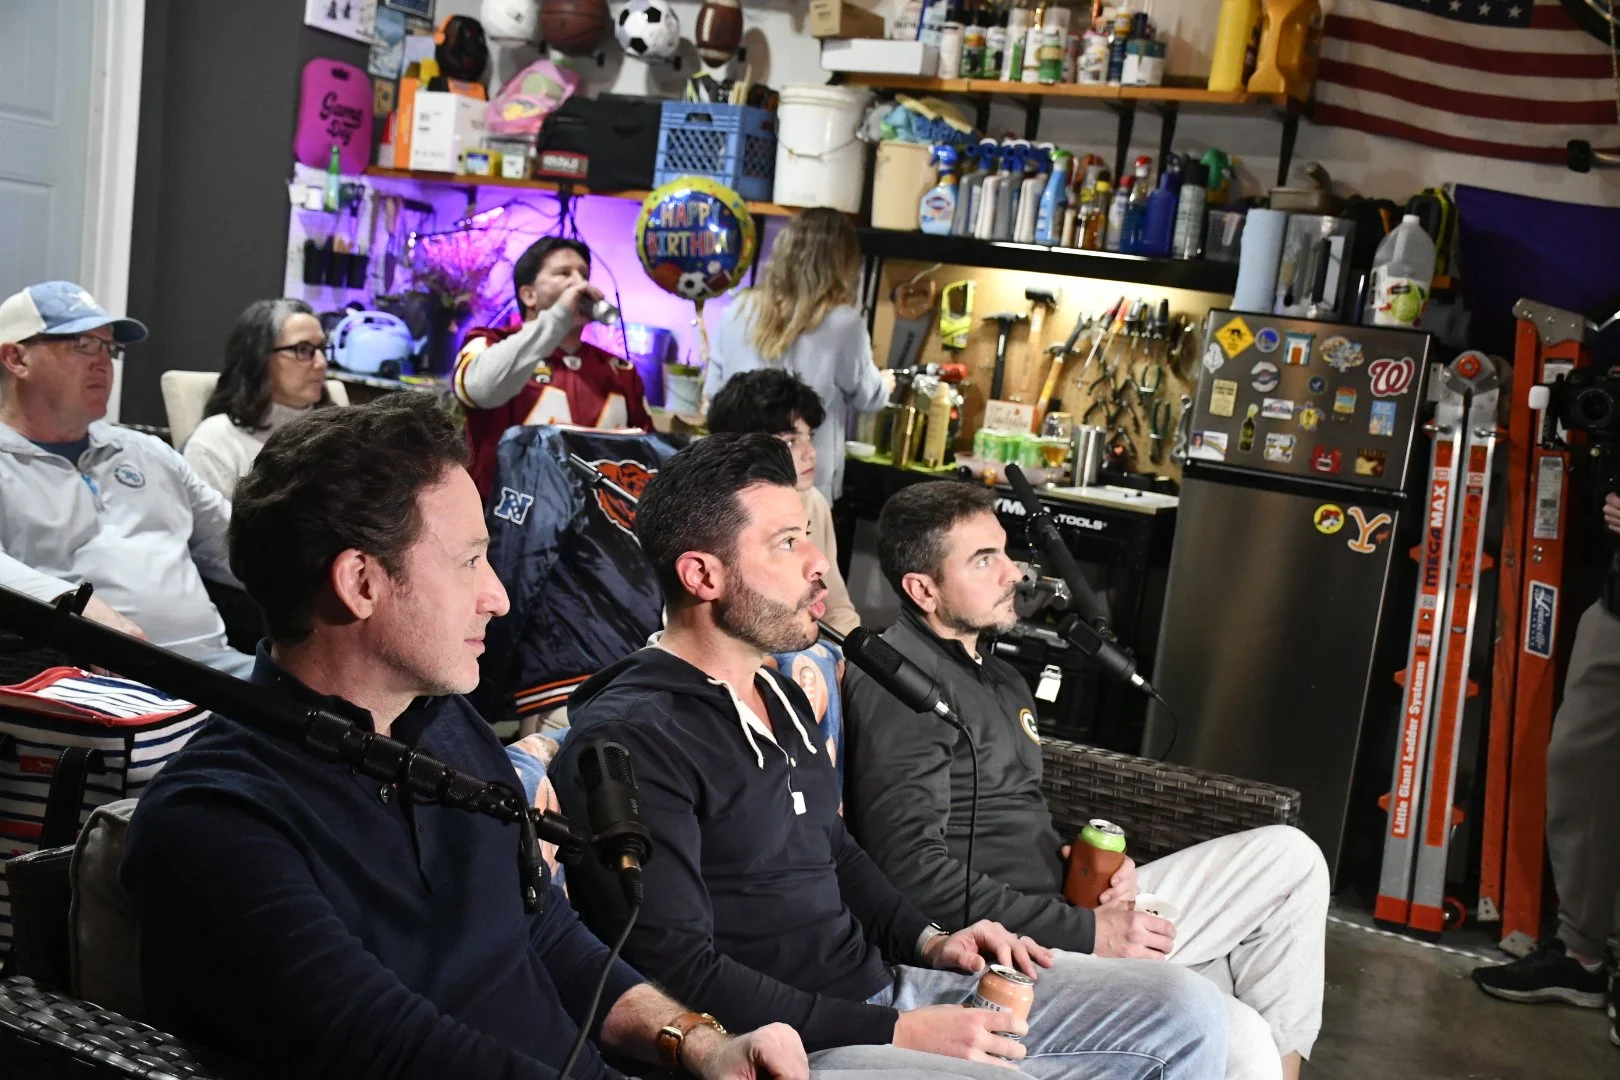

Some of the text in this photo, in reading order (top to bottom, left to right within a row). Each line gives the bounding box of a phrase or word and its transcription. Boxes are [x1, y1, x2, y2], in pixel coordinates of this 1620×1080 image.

[1368, 357, 1415, 398] W
[1058, 513, 1103, 531] TOOLS
[1347, 506, 1392, 553] Y
[1409, 660, 1426, 716] Systems
[1403, 717, 1419, 762] Ladder
[1398, 764, 1413, 798] Giant
[1394, 801, 1410, 835] Little
